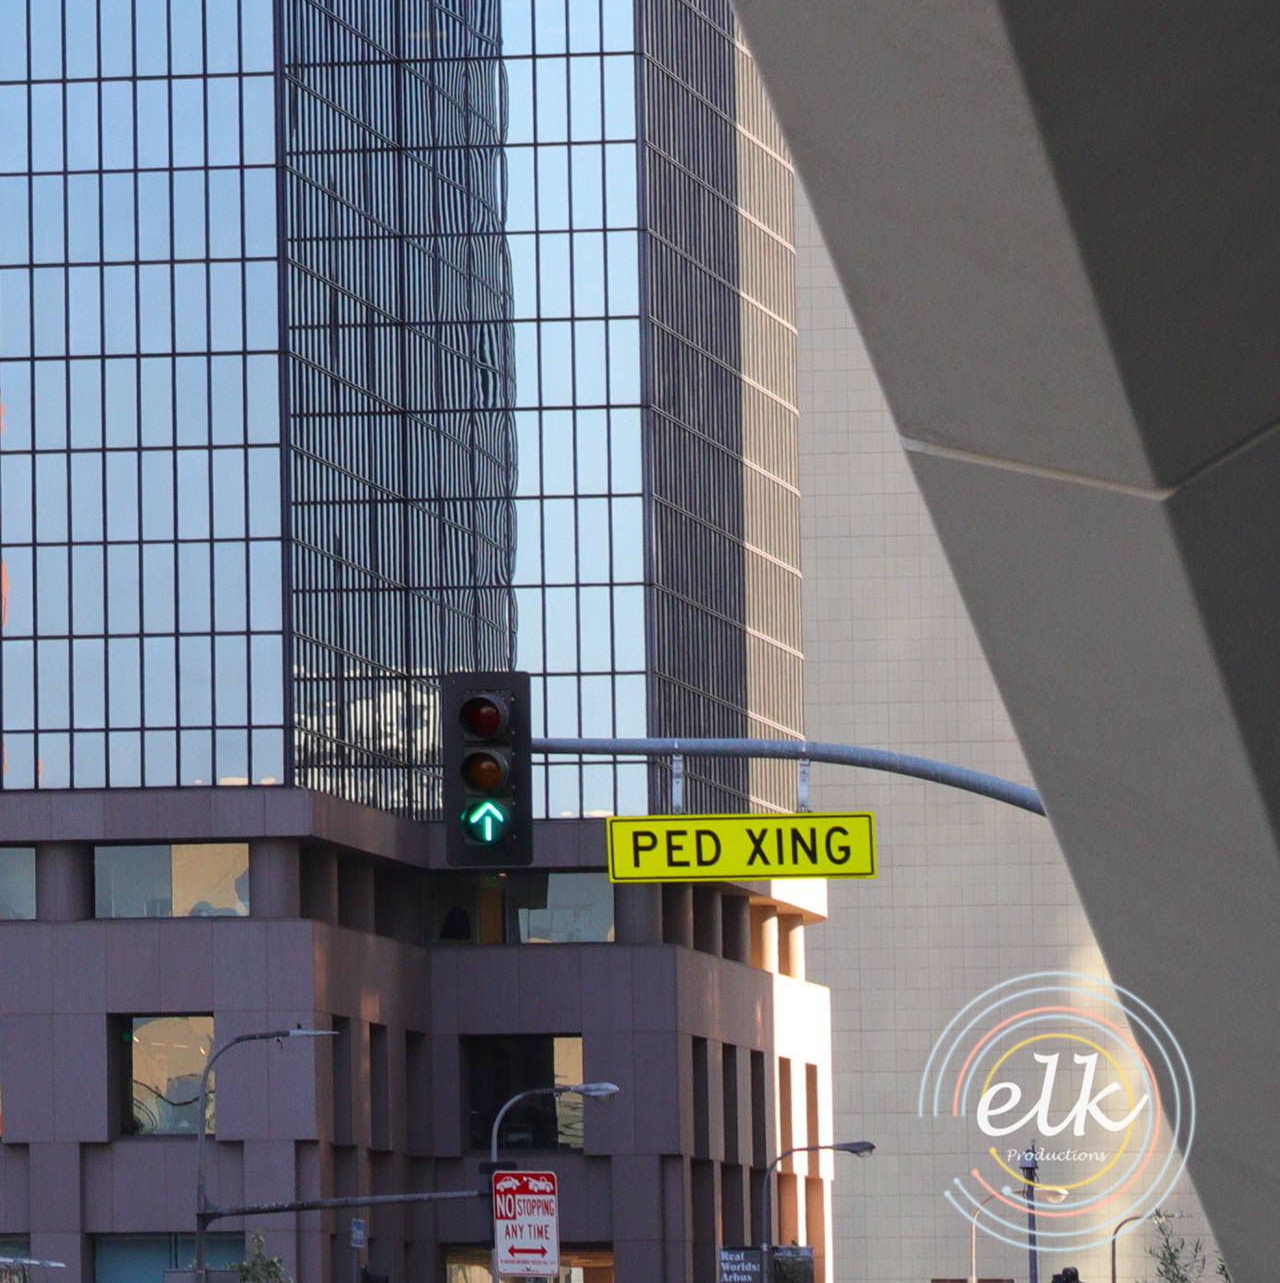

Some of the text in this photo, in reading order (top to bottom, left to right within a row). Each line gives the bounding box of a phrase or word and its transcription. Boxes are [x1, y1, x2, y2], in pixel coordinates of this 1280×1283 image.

[632, 826, 851, 867] PED XING
[496, 1194, 555, 1218] NO STOPPING
[505, 1224, 550, 1240] ANY TIME
[720, 1251, 744, 1261] Real
[720, 1262, 760, 1271] Worlds:
[721, 1273, 752, 1282] Arbus
